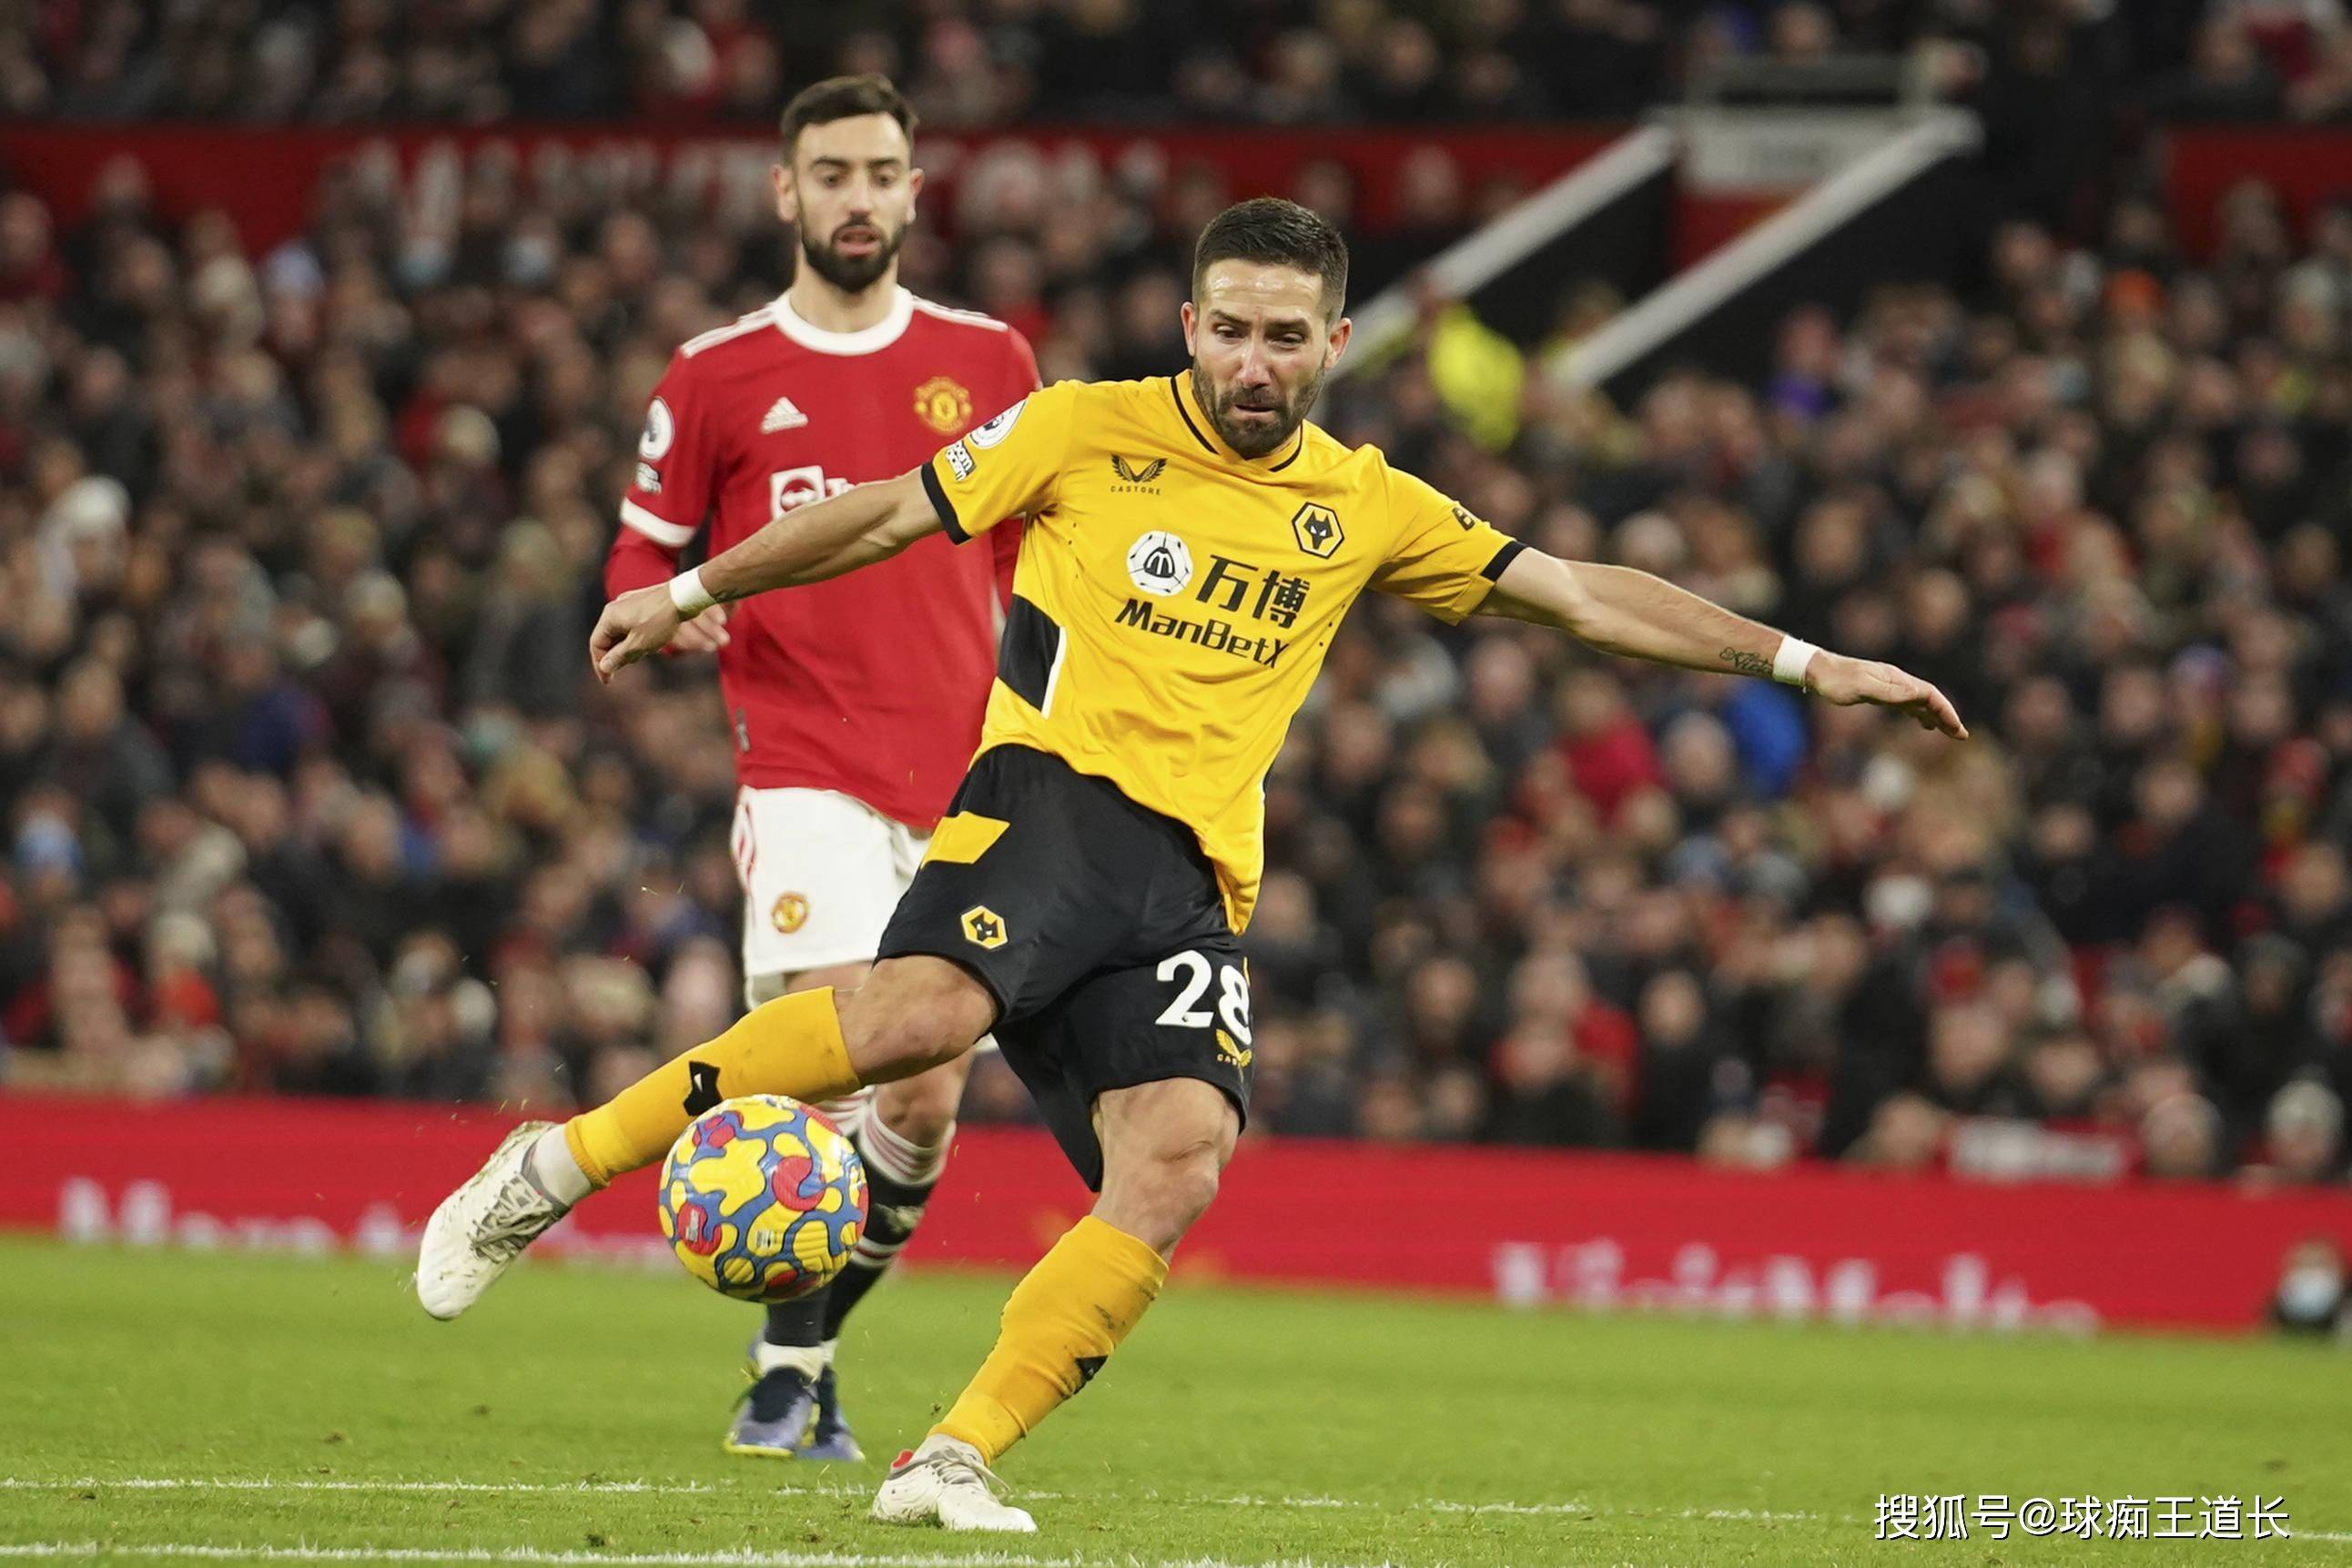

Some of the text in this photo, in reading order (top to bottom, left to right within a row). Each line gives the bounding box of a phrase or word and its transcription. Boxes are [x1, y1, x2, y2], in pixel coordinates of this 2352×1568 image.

[1110, 486, 1161, 495] CASTORE
[1195, 554, 1310, 629] 万博
[1115, 598, 1289, 669] ManBetX
[1155, 949, 1252, 1046] 28
